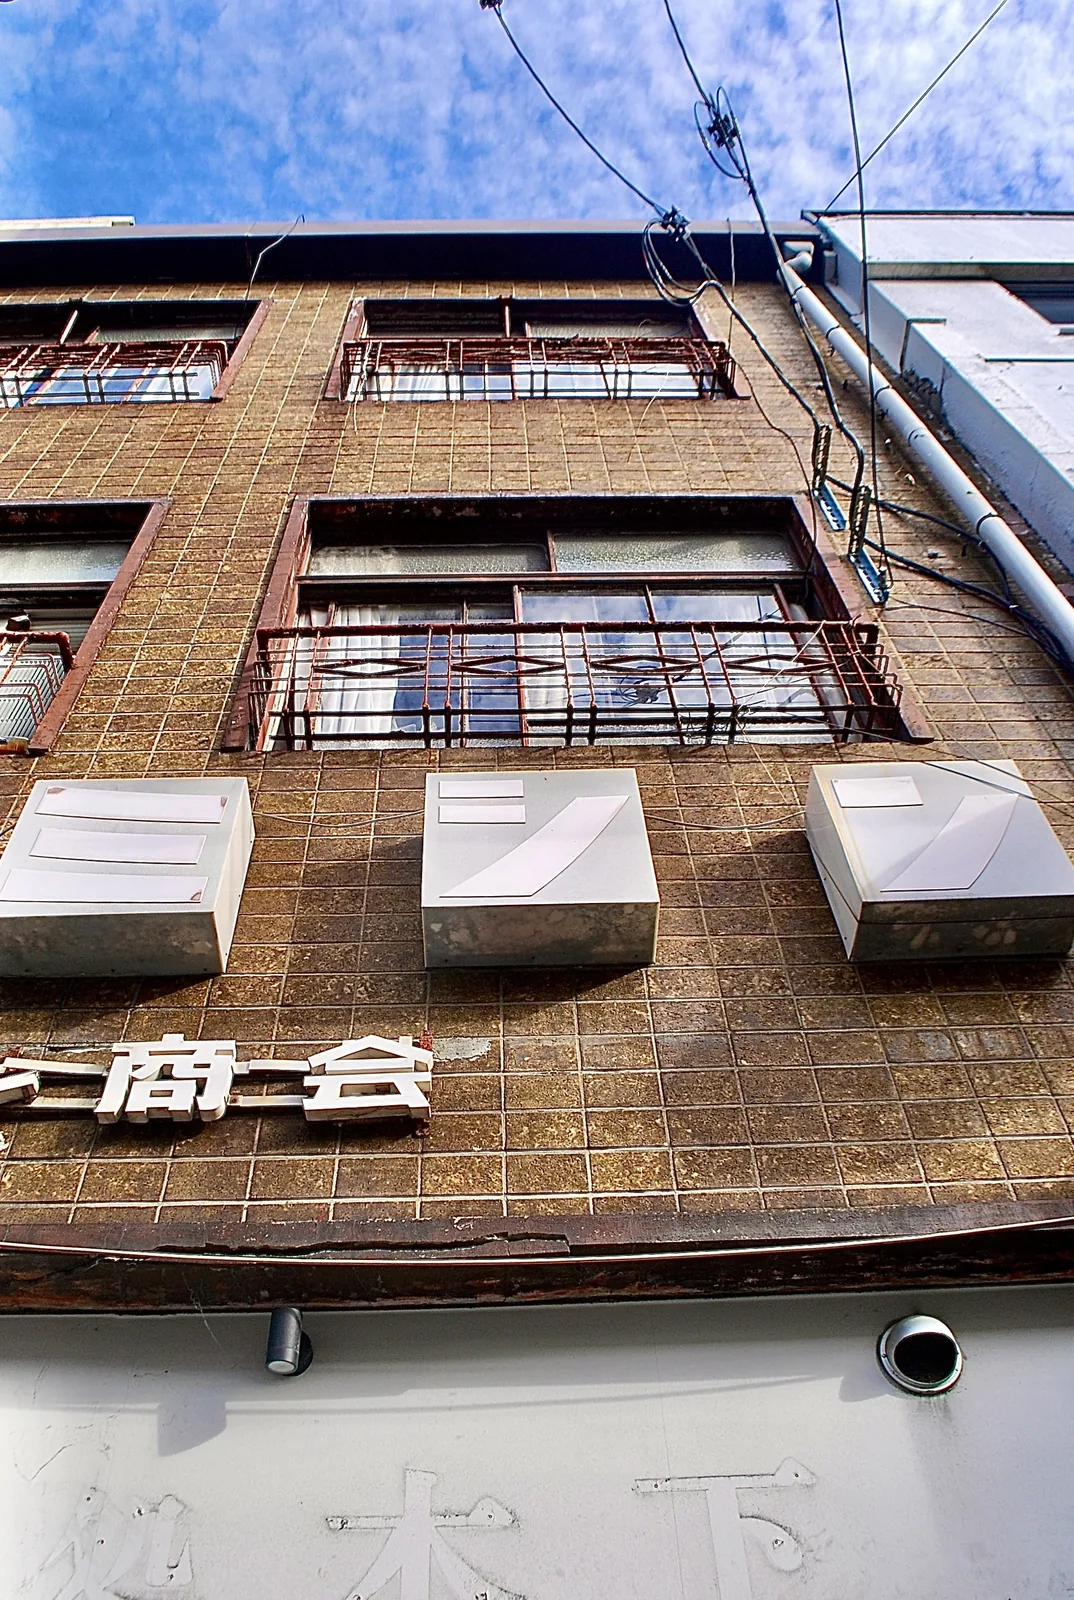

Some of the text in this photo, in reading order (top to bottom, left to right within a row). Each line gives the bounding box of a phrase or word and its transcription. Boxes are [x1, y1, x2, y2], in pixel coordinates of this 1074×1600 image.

[0, 780, 1020, 903] ミシン
[0, 1033, 434, 1126] 商会
